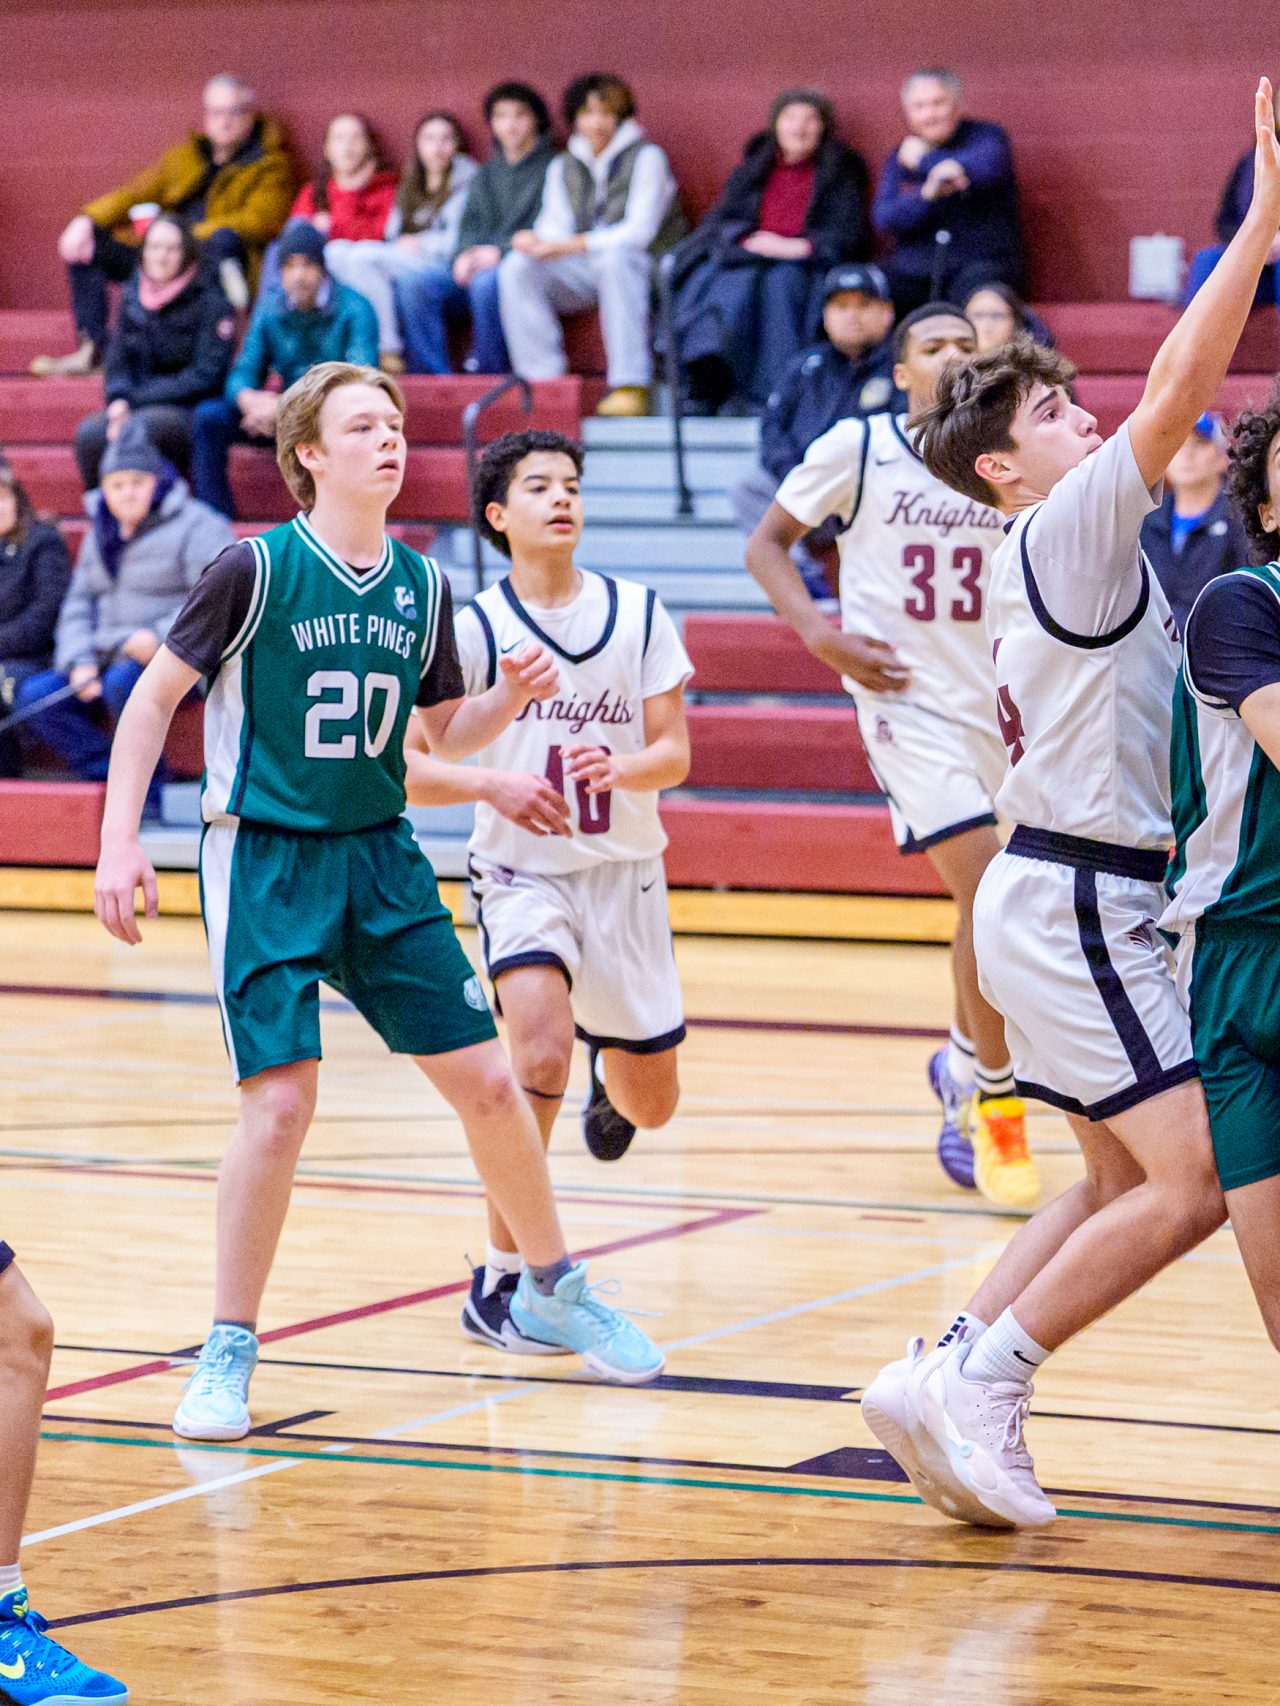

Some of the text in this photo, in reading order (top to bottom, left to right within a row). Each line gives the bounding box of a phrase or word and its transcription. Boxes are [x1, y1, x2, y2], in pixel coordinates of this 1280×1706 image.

[883, 490, 1001, 537] Knights
[903, 544, 983, 621] 33
[290, 613, 417, 660] WHITE PINES
[304, 670, 401, 759] 20
